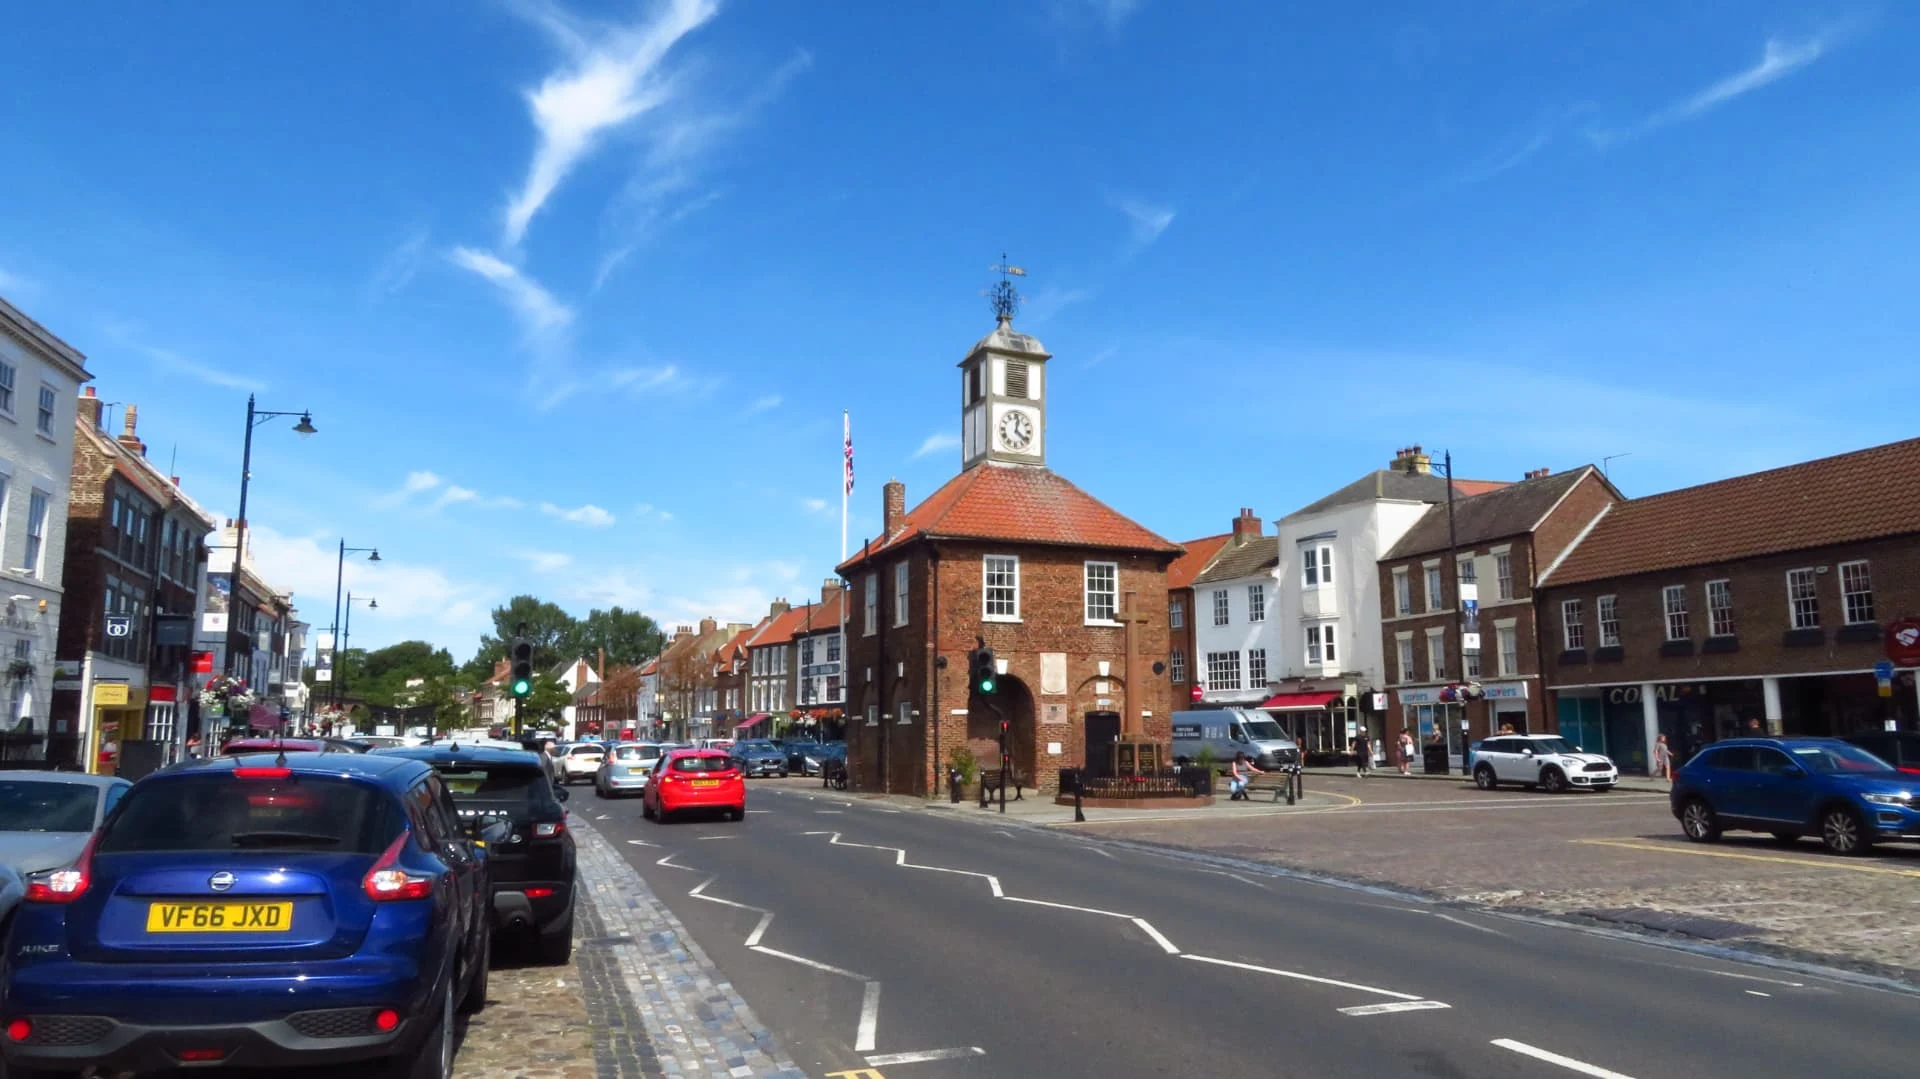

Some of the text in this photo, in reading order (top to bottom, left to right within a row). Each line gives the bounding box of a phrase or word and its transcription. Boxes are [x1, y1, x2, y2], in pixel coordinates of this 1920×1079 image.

[1610, 685, 1680, 704] COAL
[162, 906, 280, 927] VF66 JXD
